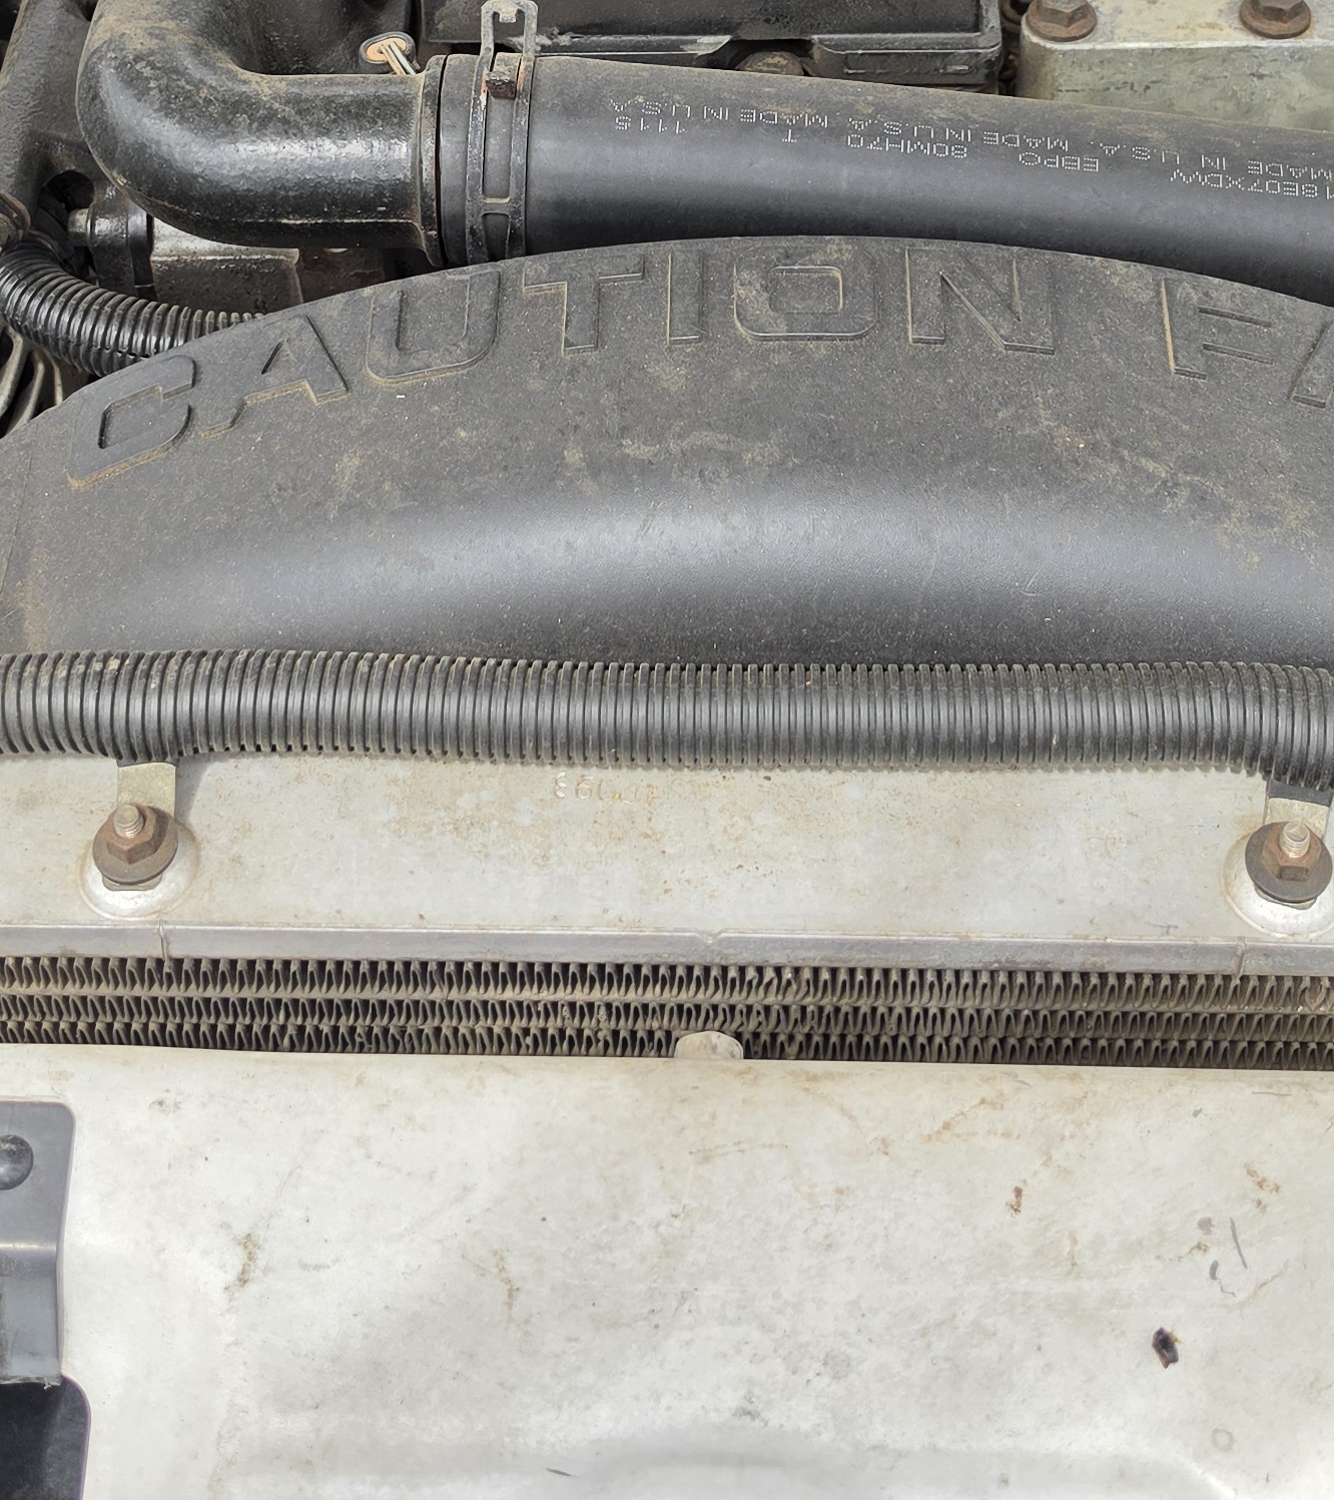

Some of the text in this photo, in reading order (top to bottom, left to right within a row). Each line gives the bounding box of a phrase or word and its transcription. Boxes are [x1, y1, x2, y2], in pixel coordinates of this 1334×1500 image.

[702, 104, 729, 121] IN
[944, 126, 972, 143] IN
[982, 129, 1069, 152] MADE
[1200, 153, 1227, 171] IN
[1246, 158, 1334, 181] MADE
[67, 245, 1057, 490] CAUTION
